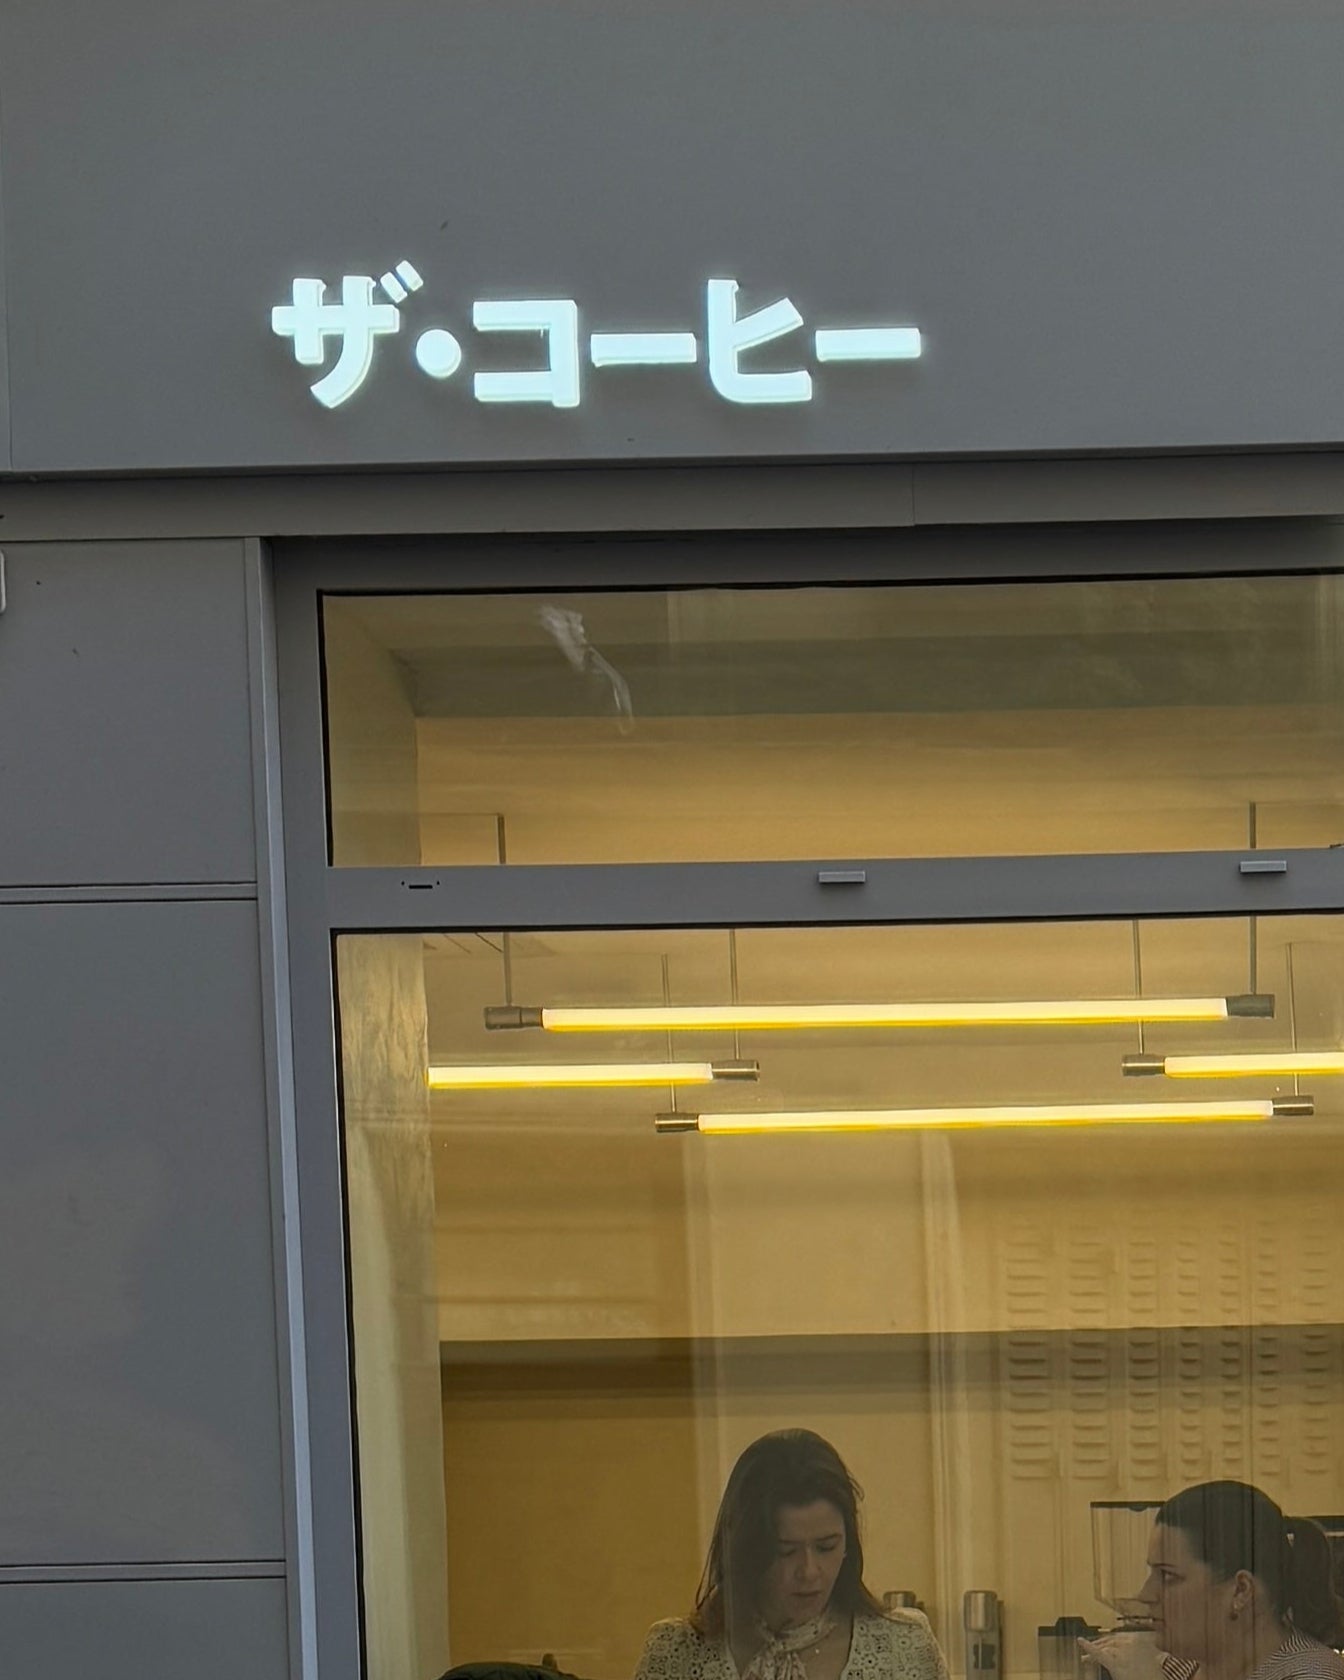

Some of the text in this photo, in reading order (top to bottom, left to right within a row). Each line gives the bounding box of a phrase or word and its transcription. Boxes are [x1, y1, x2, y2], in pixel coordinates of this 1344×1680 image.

[271, 260, 922, 408] ザ・コーヒー
